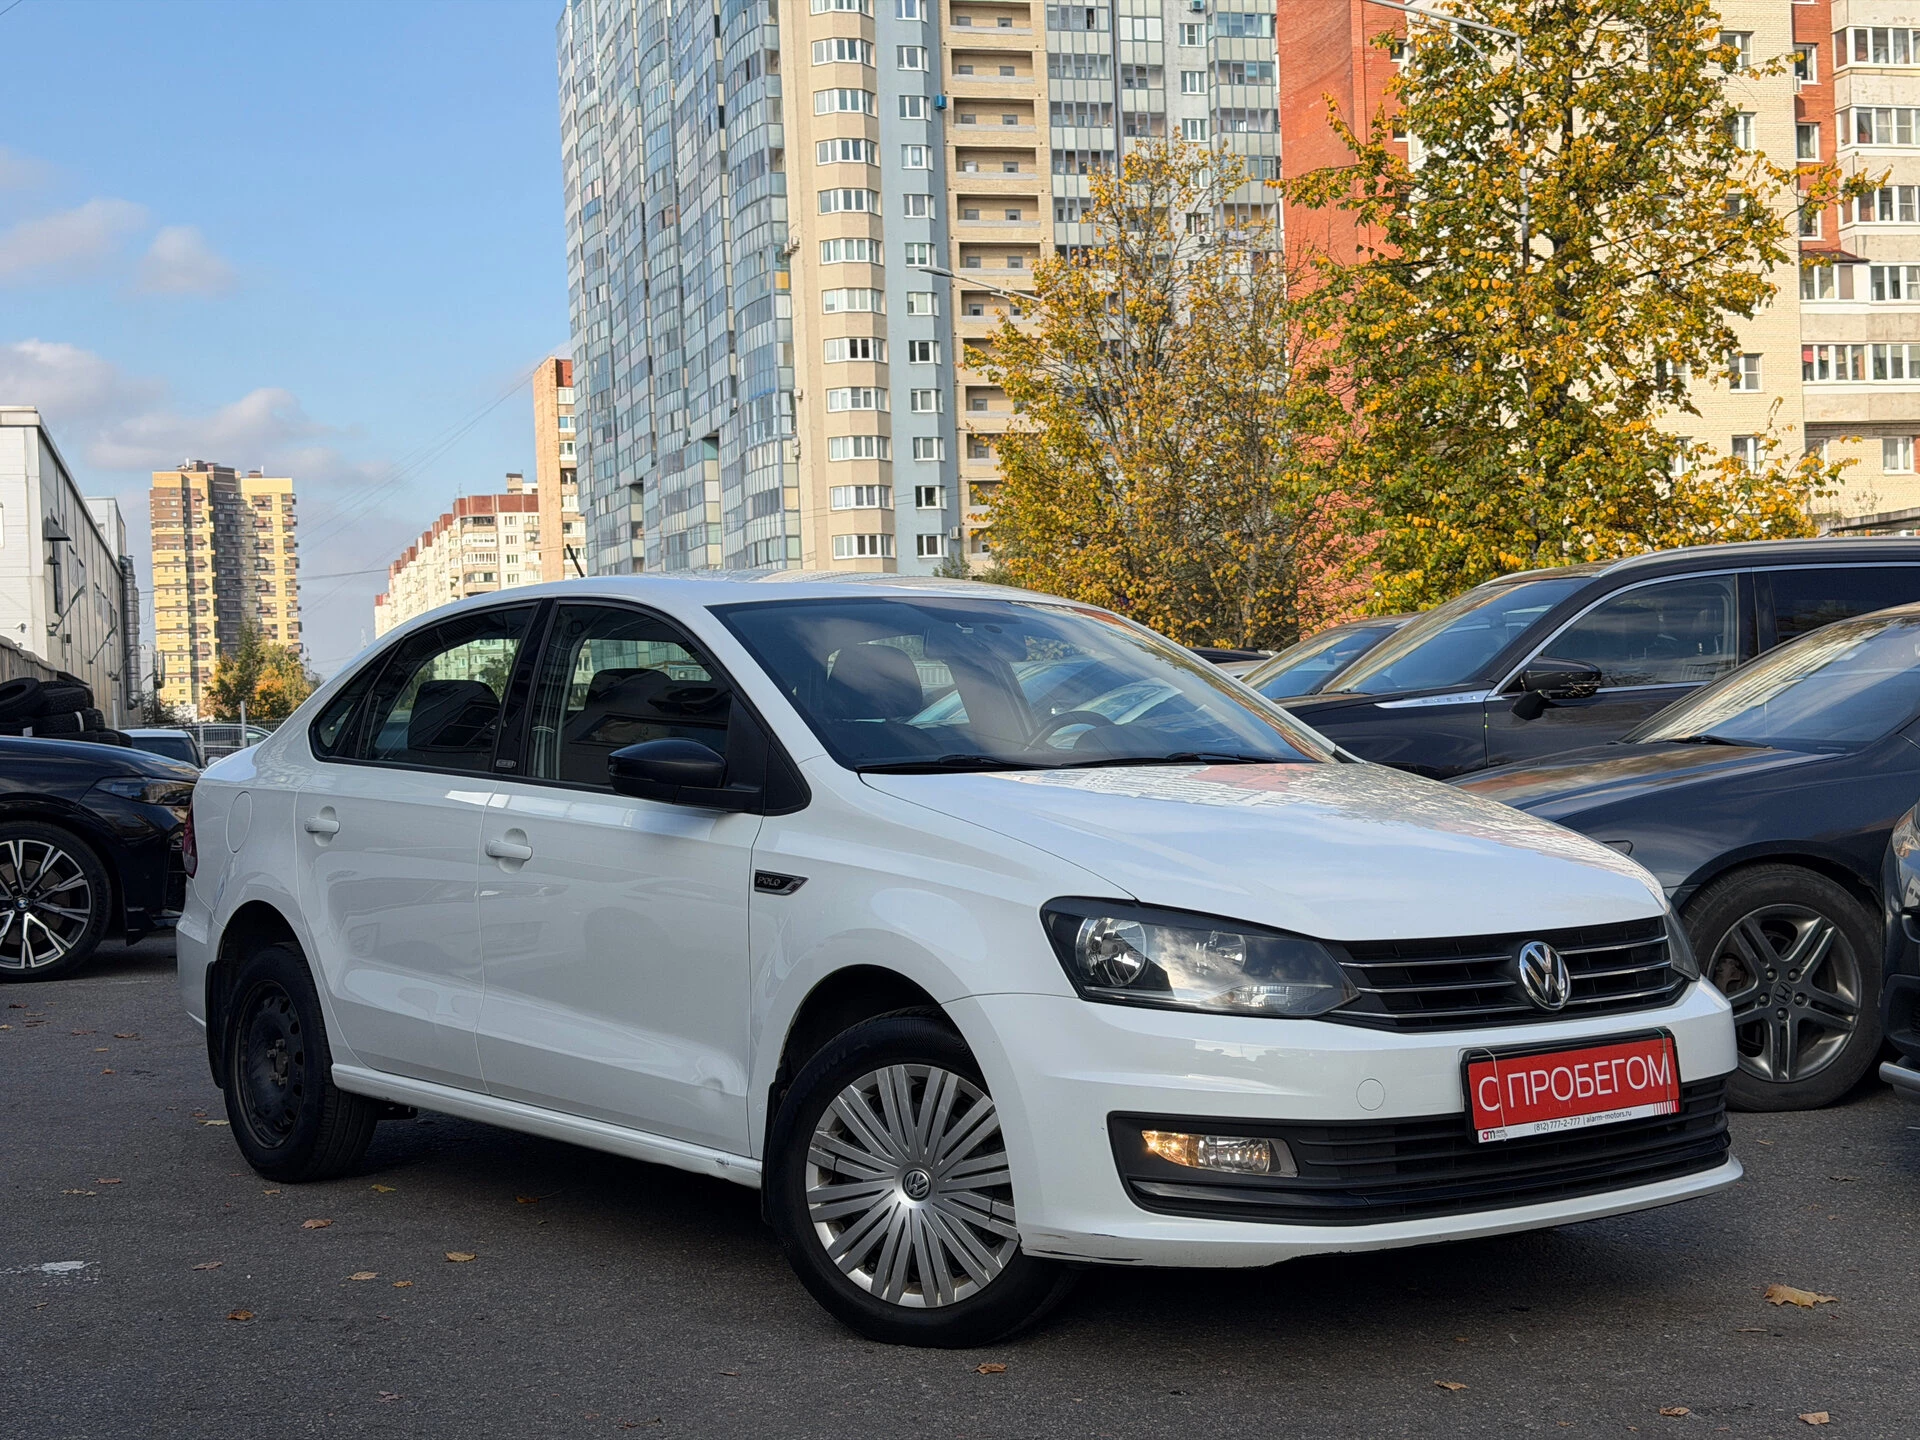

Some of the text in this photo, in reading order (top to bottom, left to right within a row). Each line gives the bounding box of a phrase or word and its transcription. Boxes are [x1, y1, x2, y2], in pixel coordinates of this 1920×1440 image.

[757, 876, 781, 887] POLO
[1478, 1054, 1671, 1111] С ПРОБЕГОМ
[1586, 1110, 1632, 1123] alarm-motors.ru
